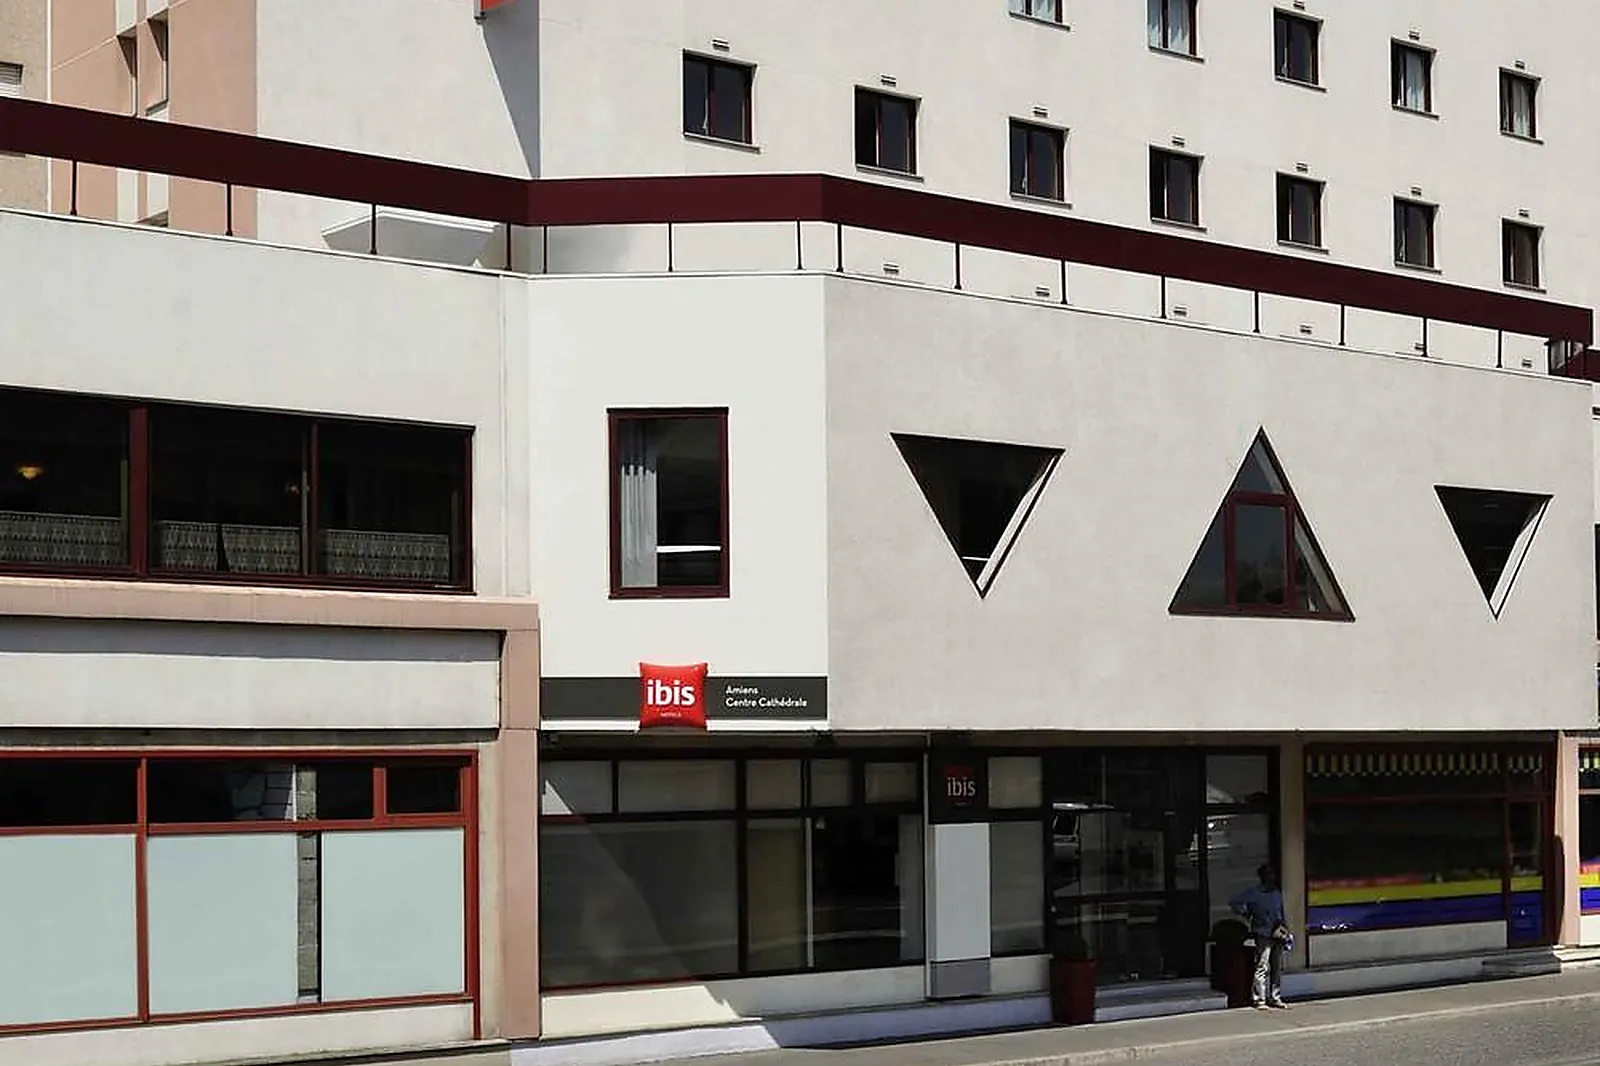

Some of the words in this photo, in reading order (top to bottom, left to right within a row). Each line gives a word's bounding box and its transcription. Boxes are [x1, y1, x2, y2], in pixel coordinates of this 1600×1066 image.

[647, 679, 695, 706] ibis
[725, 685, 758, 694] Amiens
[725, 697, 757, 707] Centre
[947, 777, 976, 797] ibis
